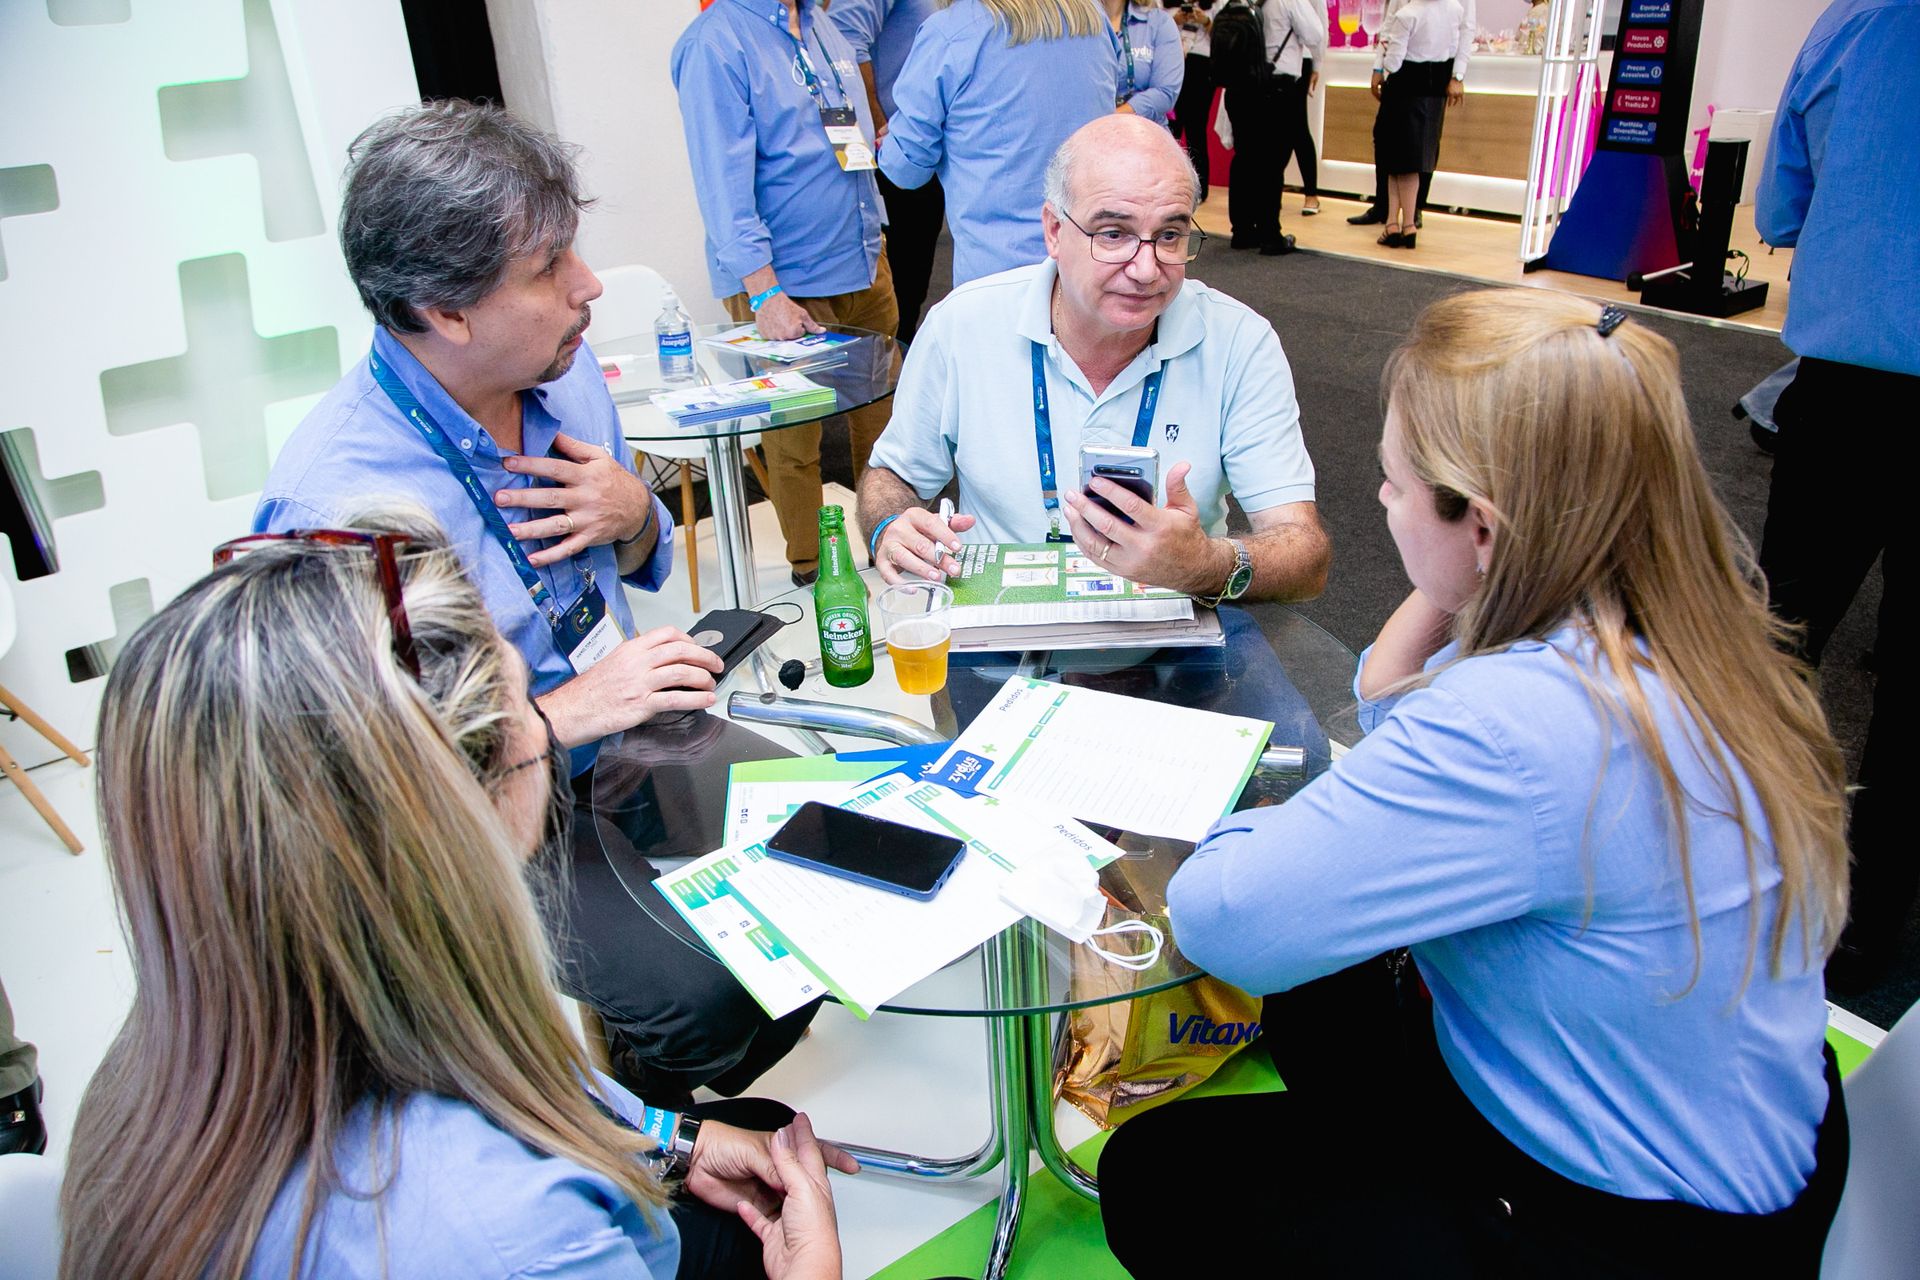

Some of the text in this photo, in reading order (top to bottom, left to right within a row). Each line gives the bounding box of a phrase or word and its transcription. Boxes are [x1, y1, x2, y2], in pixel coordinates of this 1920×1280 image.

[832, 545, 840, 576] Heineken
[823, 628, 864, 641] Heineken
[999, 688, 1023, 711] Pedidos
[948, 756, 979, 783] zydus
[1053, 824, 1092, 851] Pedidos
[1169, 1012, 1262, 1046] Vitax
